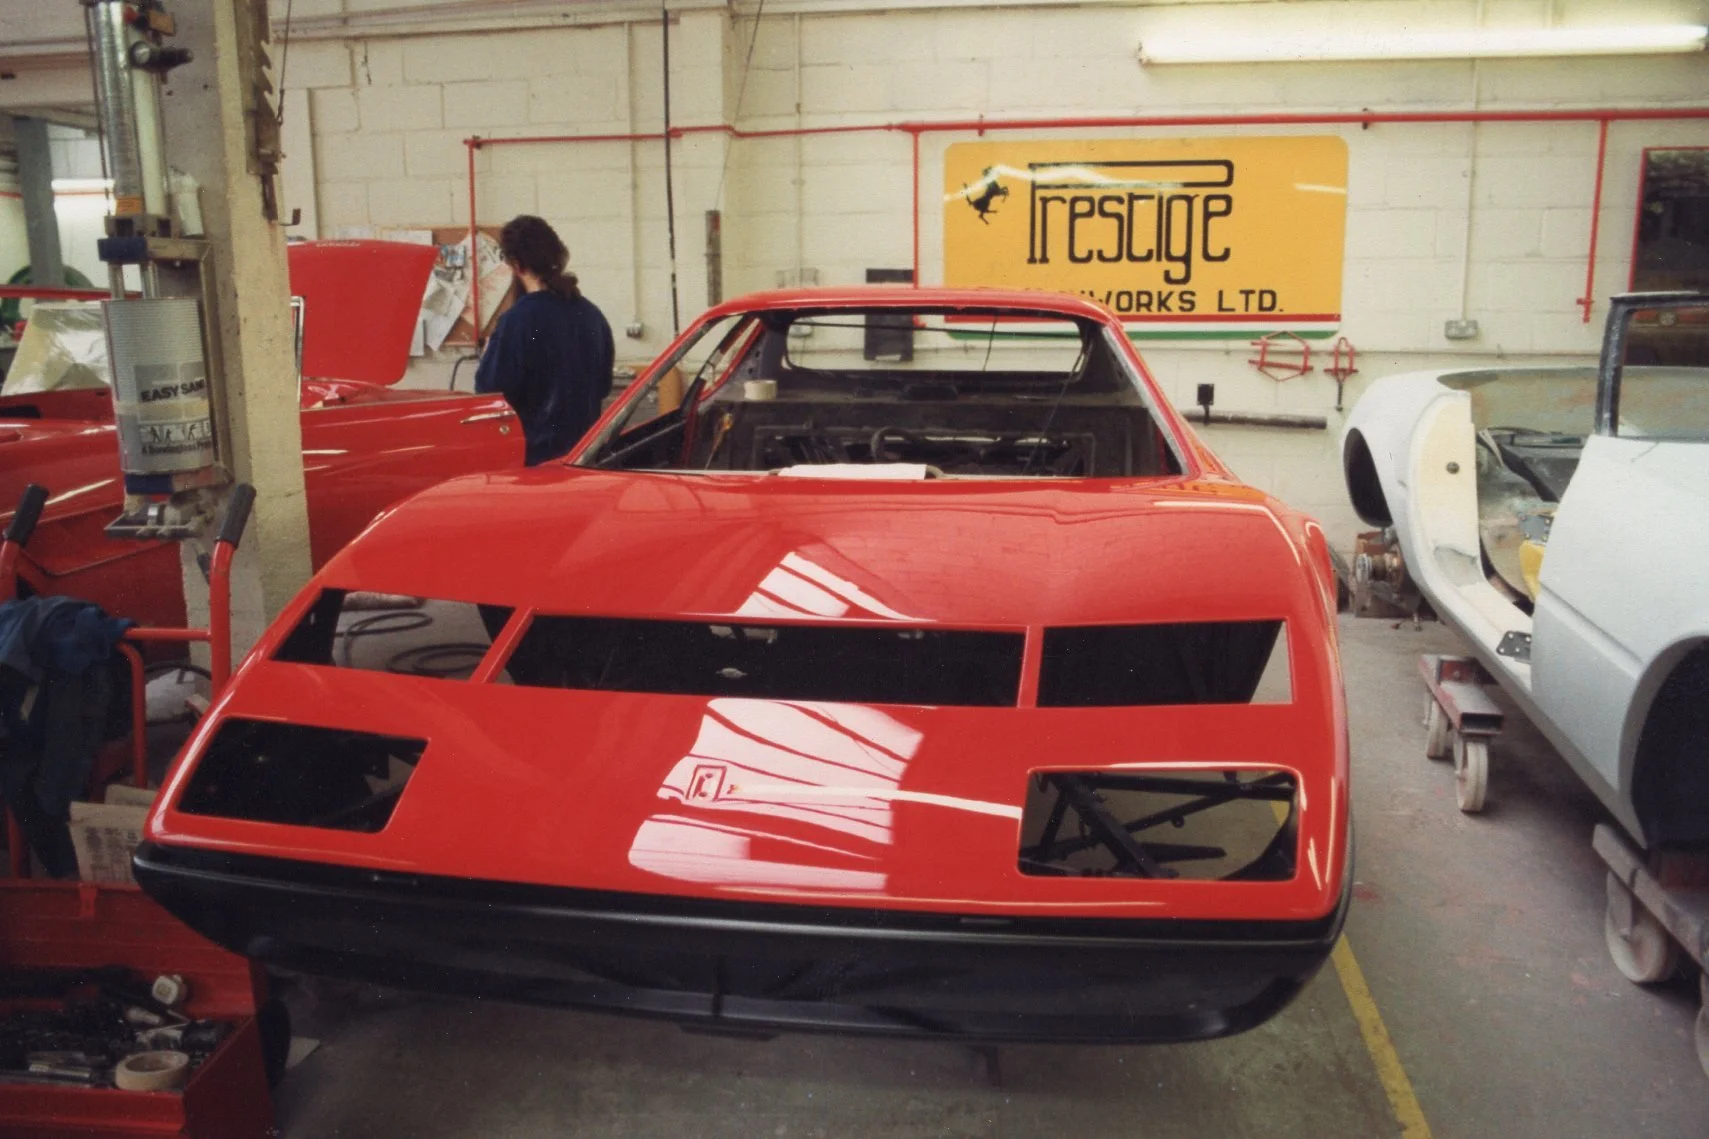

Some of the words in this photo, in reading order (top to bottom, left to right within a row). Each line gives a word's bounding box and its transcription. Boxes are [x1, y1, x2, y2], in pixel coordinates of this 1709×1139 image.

[1027, 159, 1234, 285] Prestige
[1218, 289, 1285, 312] LTD.
[140, 385, 179, 402] EASY
